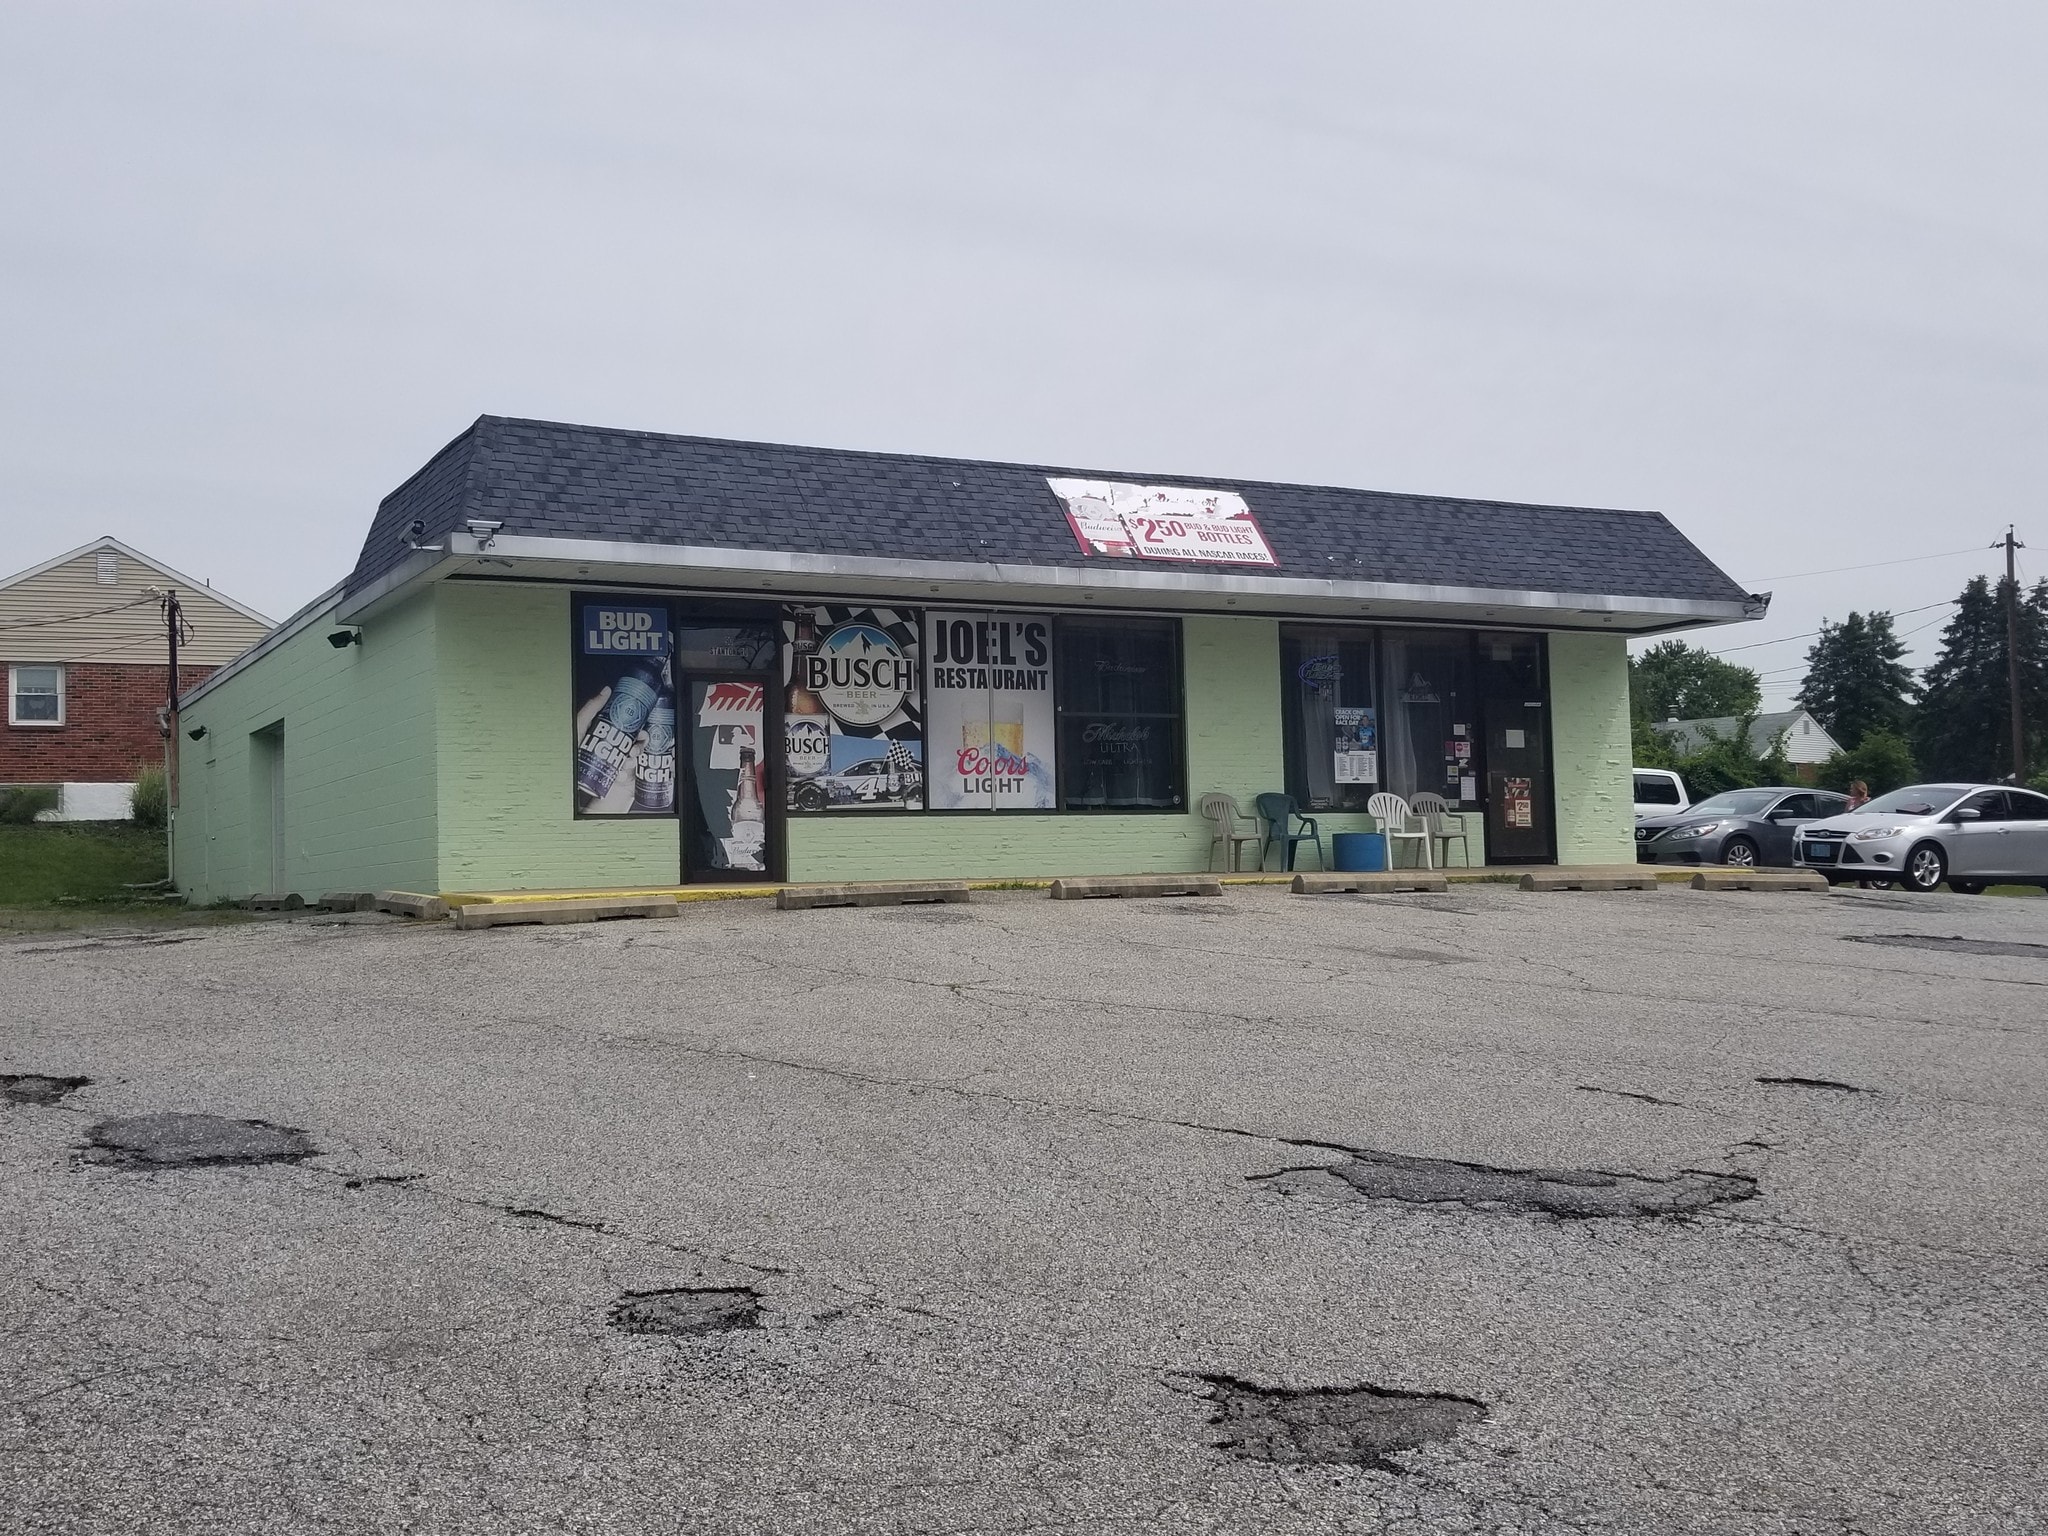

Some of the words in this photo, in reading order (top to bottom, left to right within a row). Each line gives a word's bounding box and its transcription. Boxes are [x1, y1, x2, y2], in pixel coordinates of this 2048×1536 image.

[1185, 522, 1203, 531] BUD
[1212, 524, 1230, 533] BUD
[1231, 526, 1254, 534] LIGHT
[1197, 531, 1253, 545] BOTTLES
[1144, 546, 1181, 556] DURING
[1182, 548, 1198, 557] ALL
[1199, 549, 1236, 560] NASCAR
[1236, 551, 1269, 561] RACES!
[600, 611, 653, 631] BUD
[589, 630, 663, 650] LIGHT
[933, 619, 1048, 667] JOEL'S
[806, 656, 914, 691] BUSCH
[934, 667, 1048, 690] RESTAURANT
[846, 691, 877, 699] BEER
[593, 720, 633, 754] BUD
[784, 737, 830, 755] BUSCH
[1100, 742, 1139, 753] ULTRA
[638, 753, 673, 769] BUD
[956, 747, 1030, 776] Coors
[856, 776, 881, 801] 4
[963, 777, 1025, 794] LIGHT
